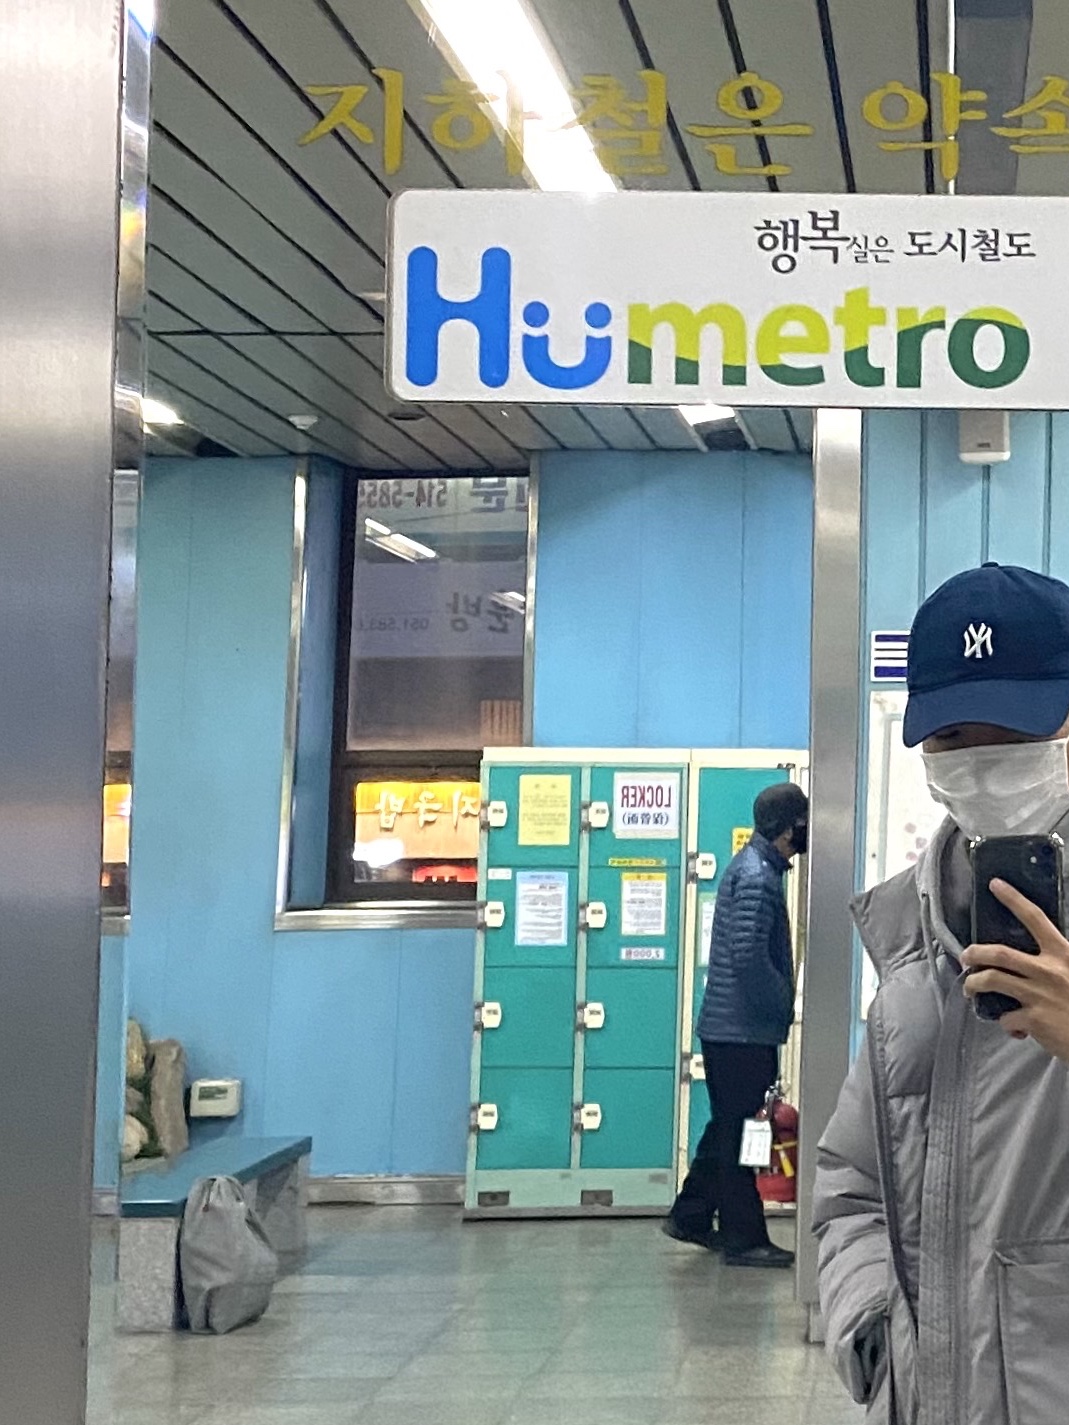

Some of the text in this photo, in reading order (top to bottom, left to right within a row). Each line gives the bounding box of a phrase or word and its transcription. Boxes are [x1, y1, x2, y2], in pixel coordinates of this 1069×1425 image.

[297, 67, 813, 178] 지하철은
[753, 209, 1037, 274] 행복실은 도시철도
